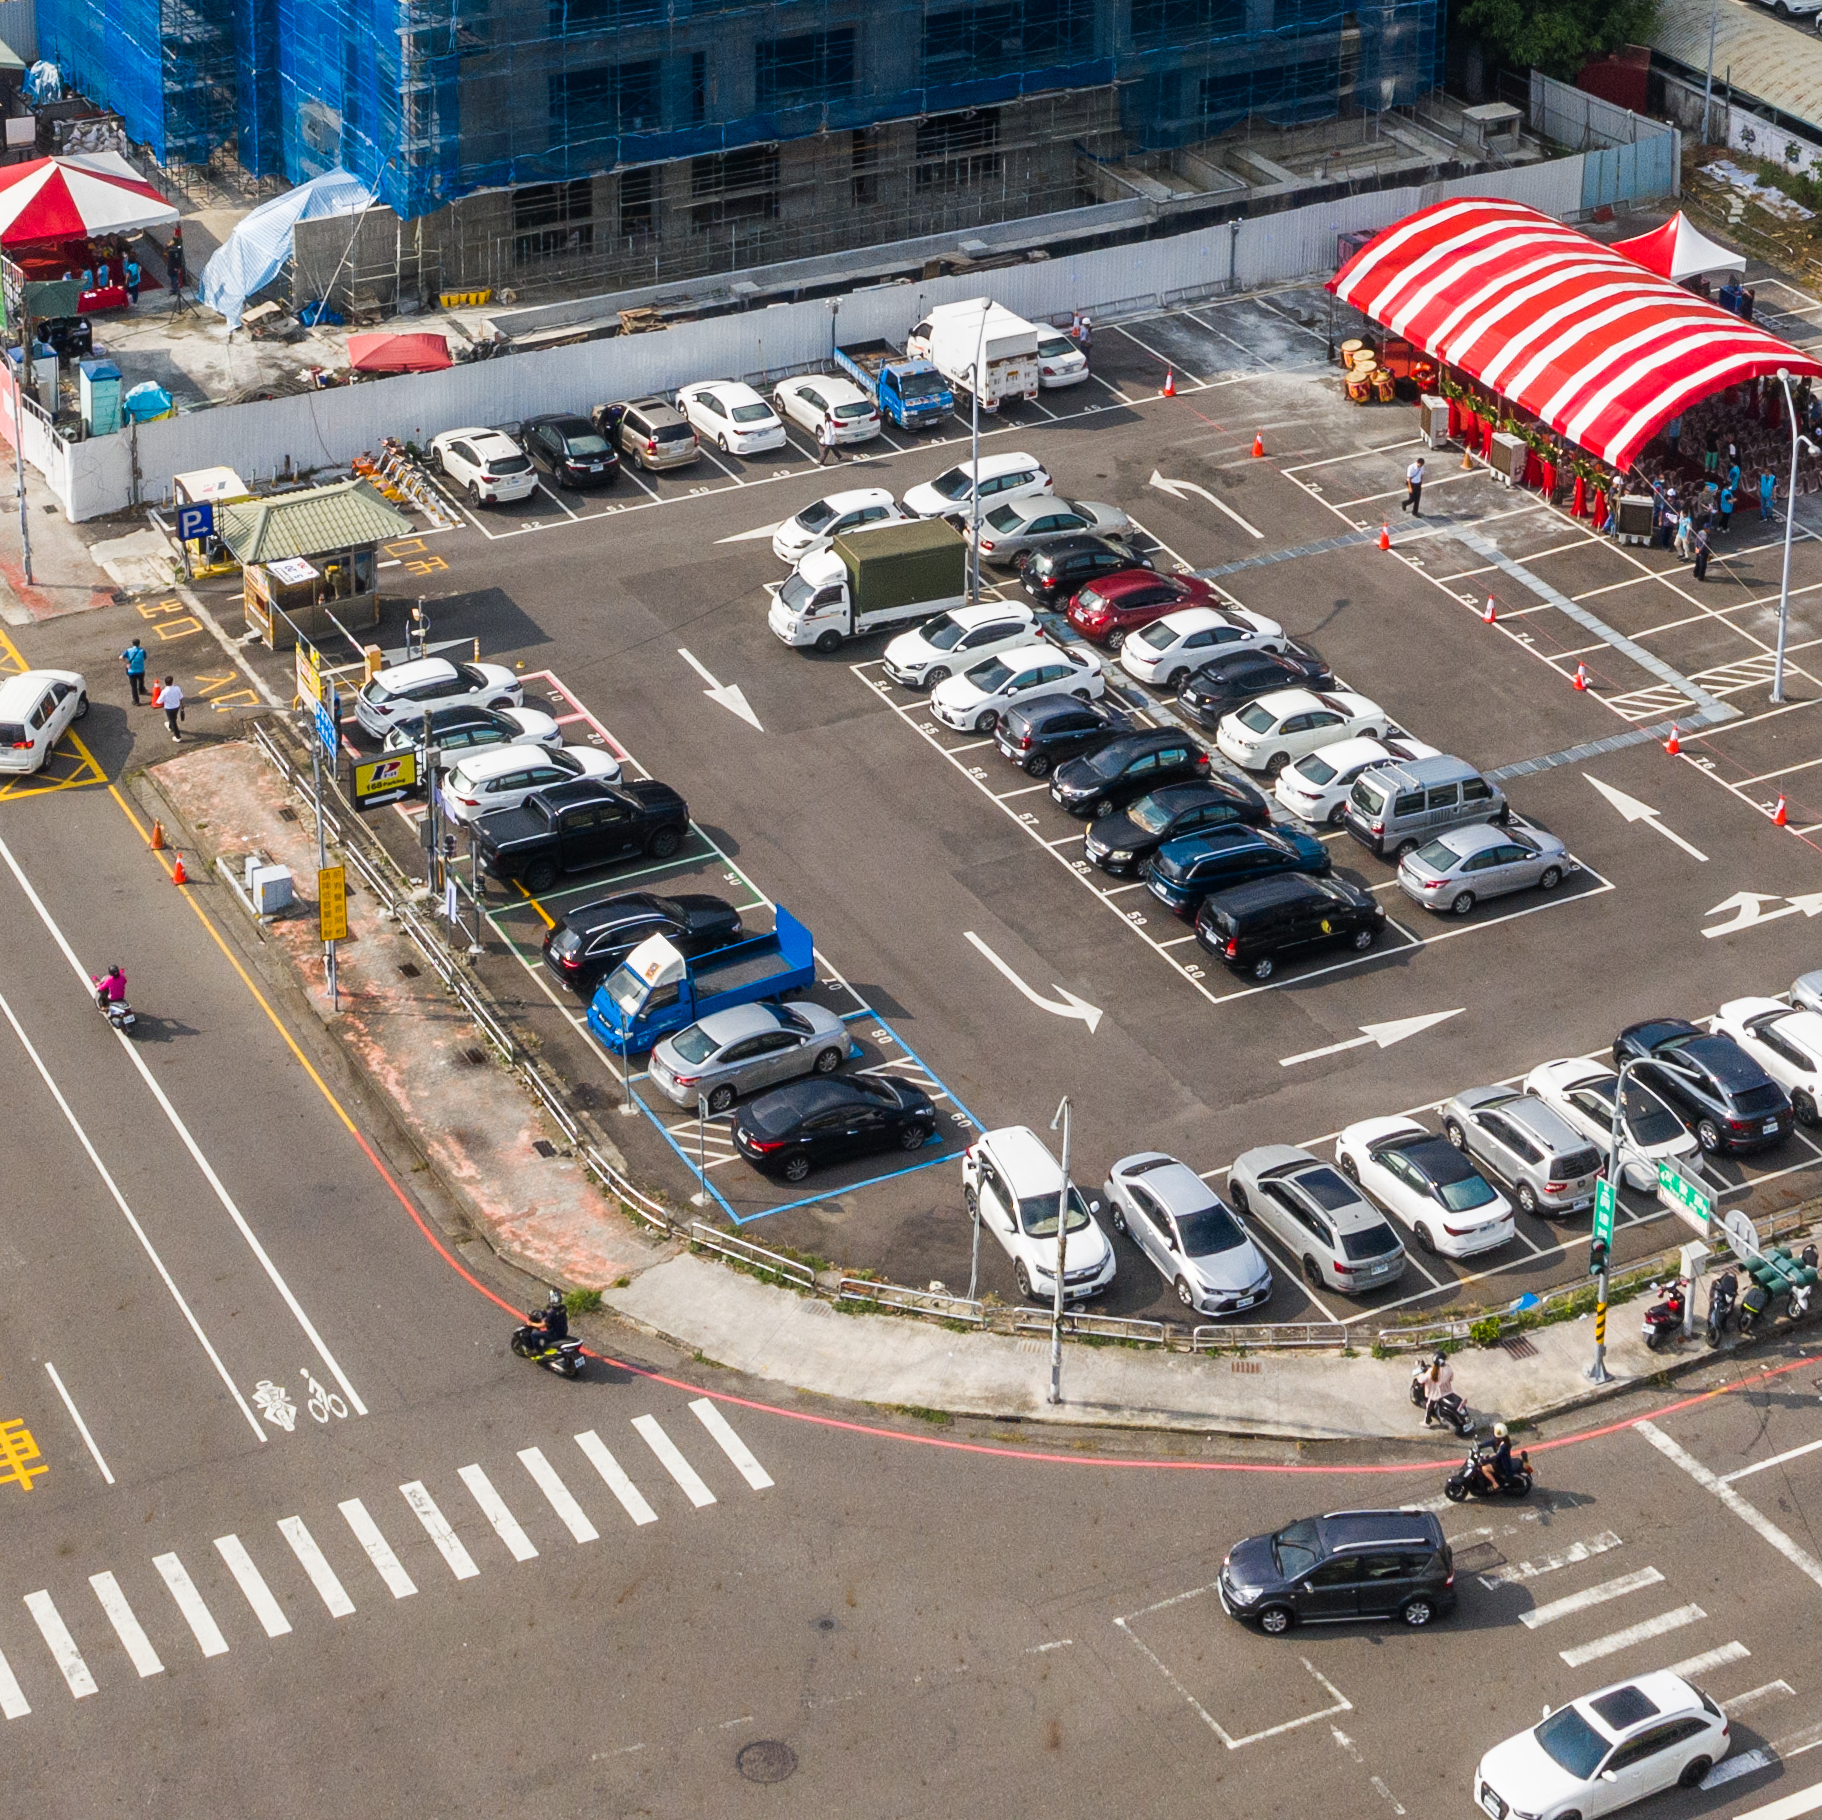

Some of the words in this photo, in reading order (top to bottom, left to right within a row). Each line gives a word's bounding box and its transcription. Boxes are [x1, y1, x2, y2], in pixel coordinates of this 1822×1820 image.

[183, 509, 203, 538] P
[919, 722, 940, 735] 55
[968, 766, 988, 780] 56
[1018, 812, 1040, 825] 57
[1071, 860, 1093, 874] 58
[1126, 911, 1148, 926] 59
[1184, 964, 1206, 979] 60
